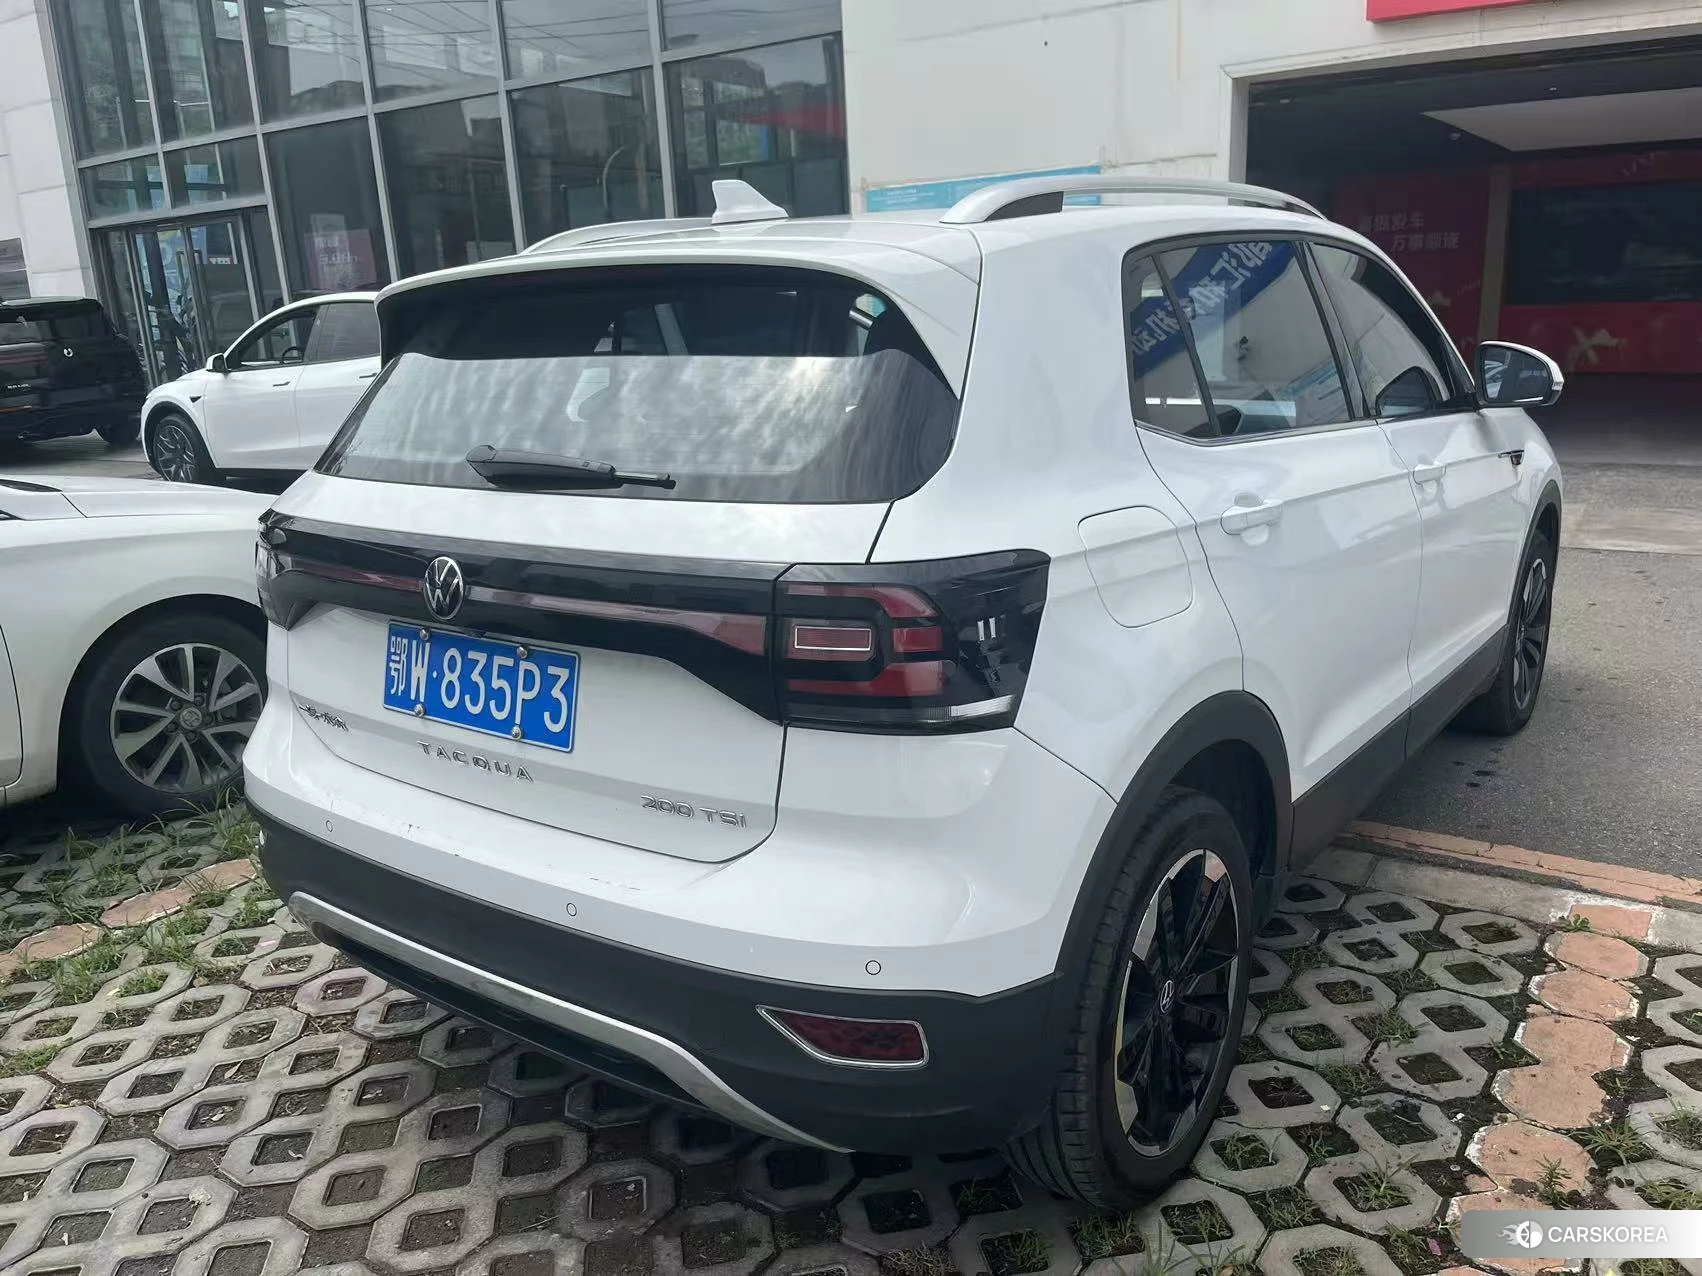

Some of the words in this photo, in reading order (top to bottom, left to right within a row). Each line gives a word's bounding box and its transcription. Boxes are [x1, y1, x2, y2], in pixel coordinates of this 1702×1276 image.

[416, 740, 534, 783] TACQUA
[640, 795, 695, 818] 200
[699, 807, 747, 829] TSI
